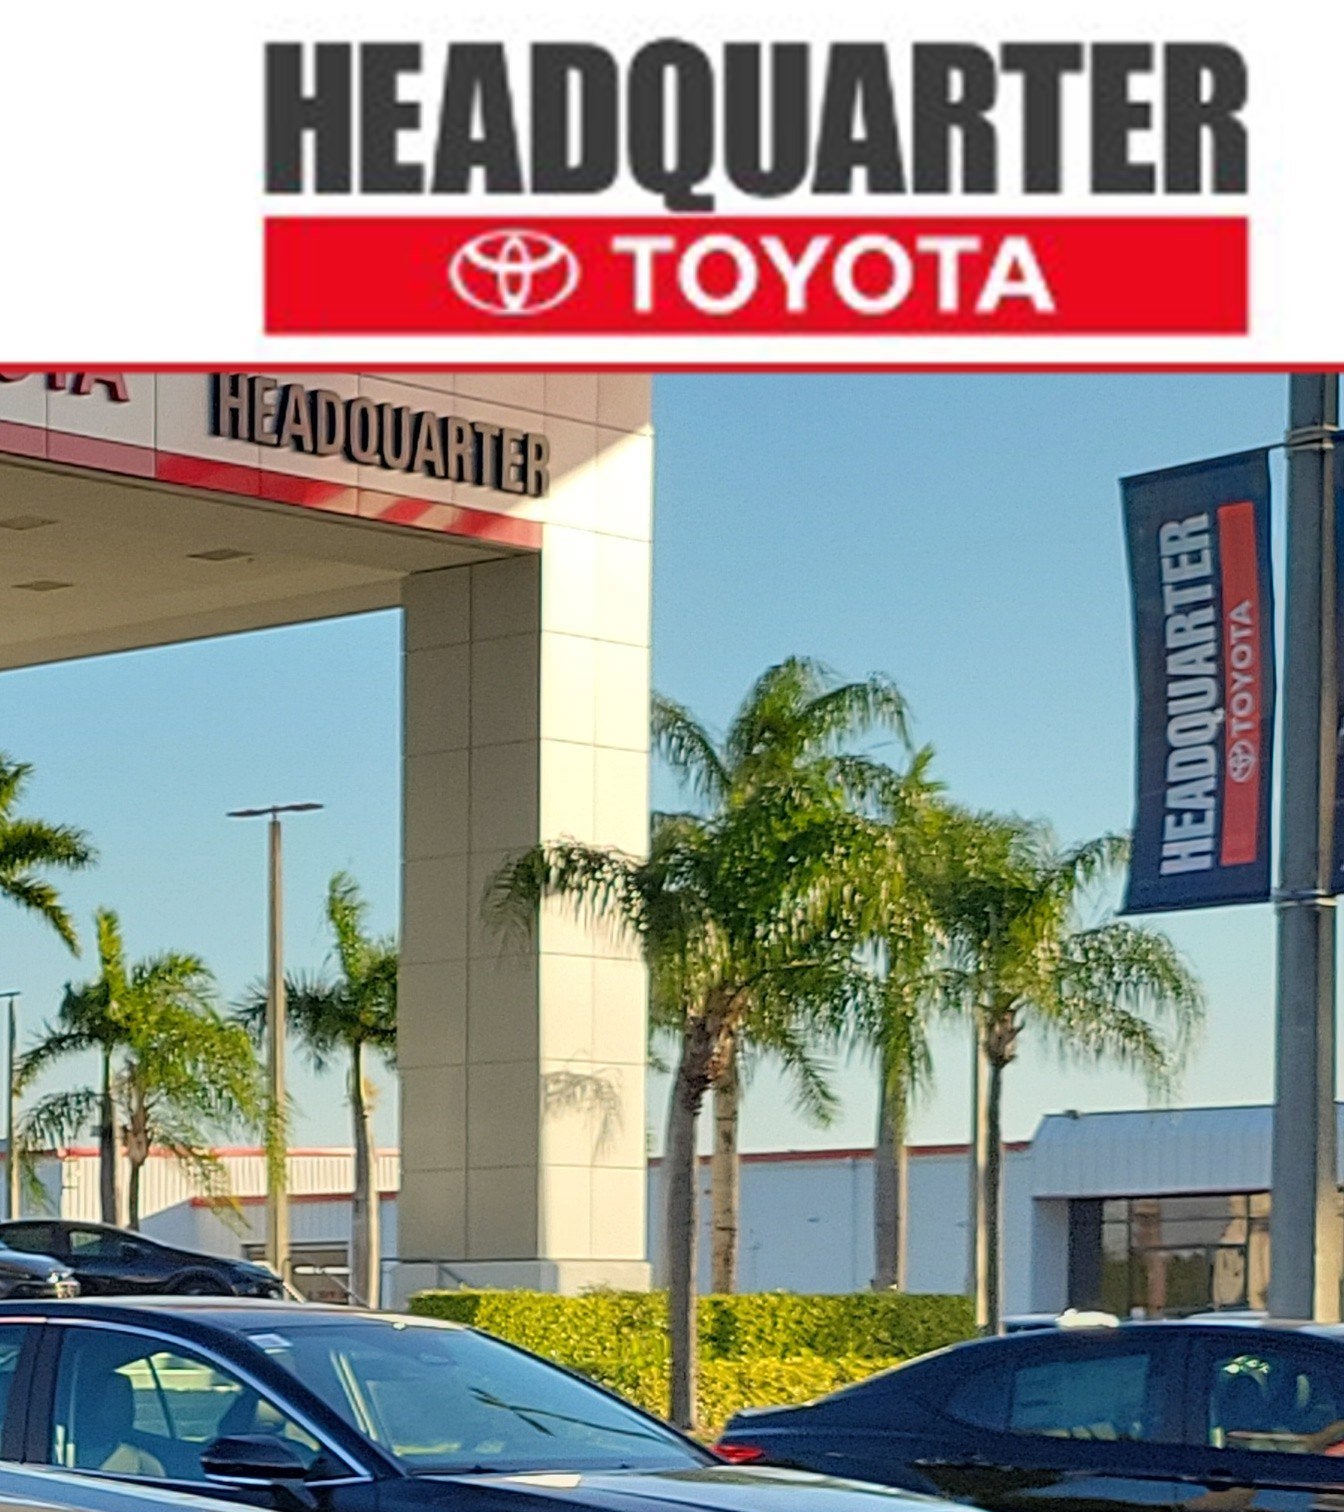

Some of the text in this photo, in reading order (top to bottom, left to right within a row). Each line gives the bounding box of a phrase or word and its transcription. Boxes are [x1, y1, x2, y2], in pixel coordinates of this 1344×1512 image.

[212, 373, 550, 497] HEADQUARTER
[1159, 512, 1224, 877] HEADQUARTER
[1228, 599, 1254, 738] TOYOTA
